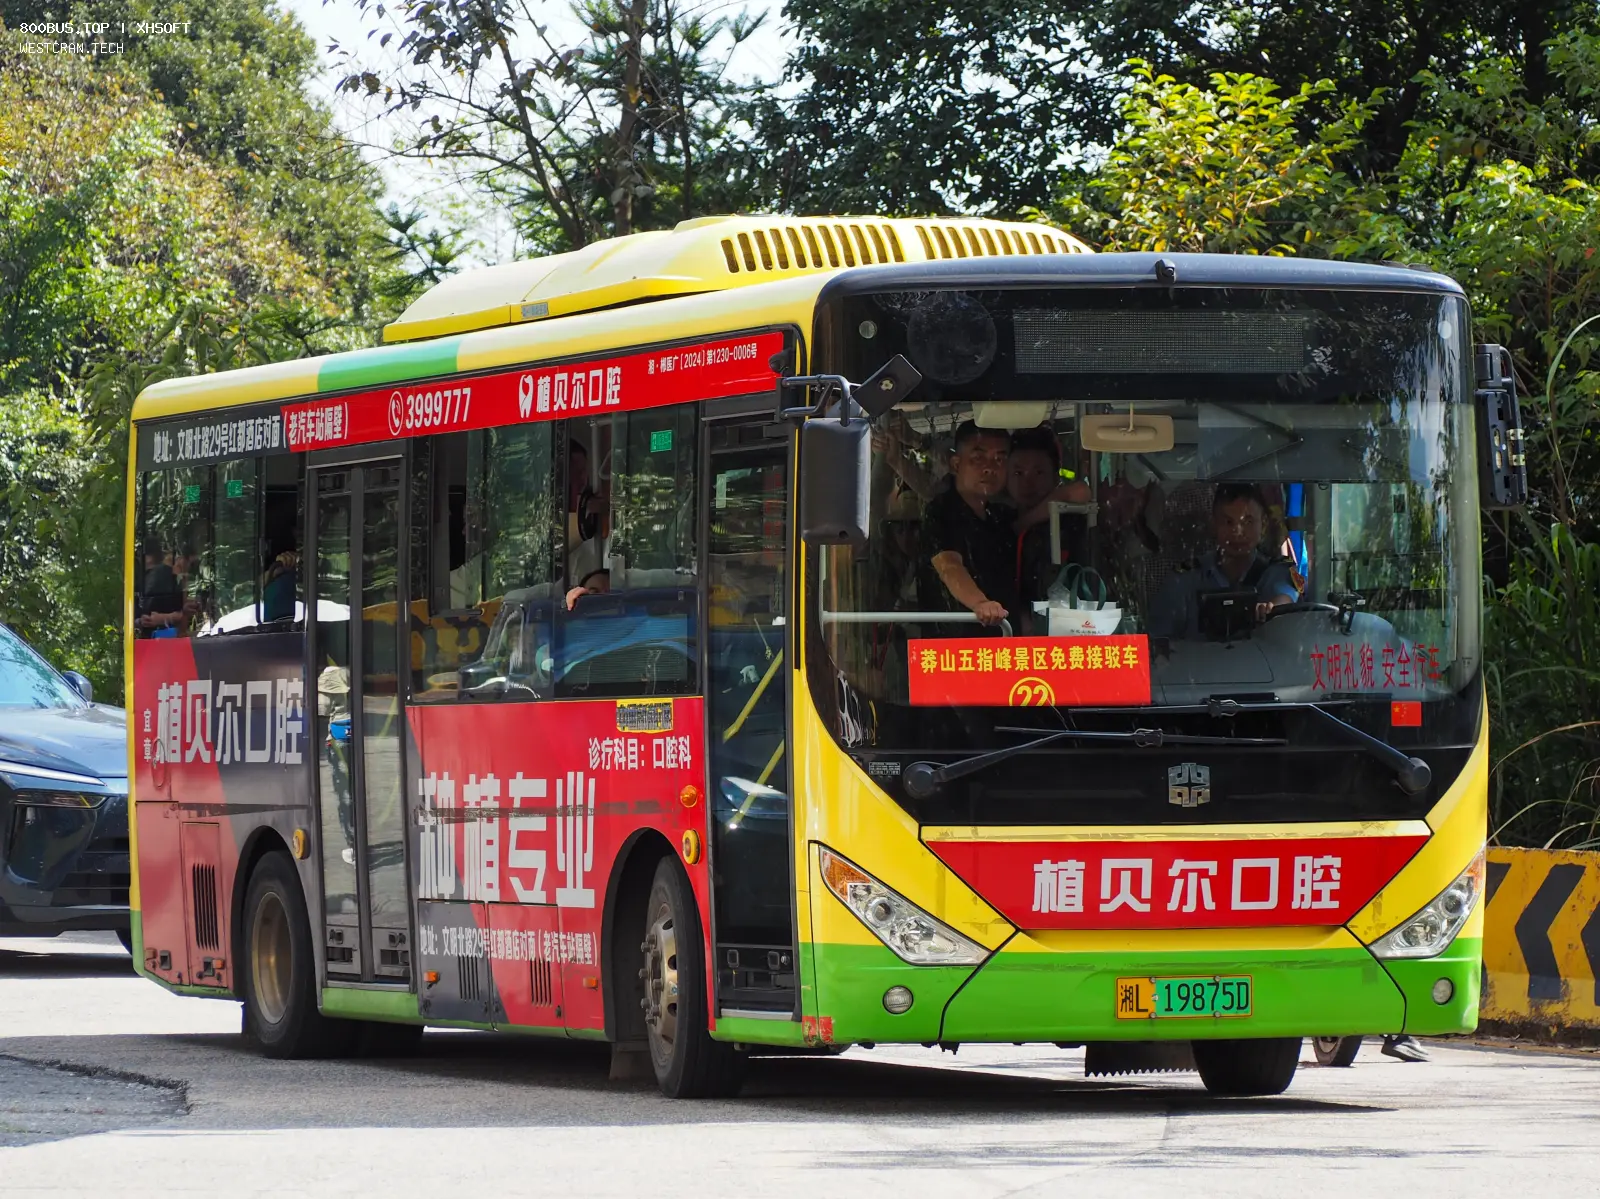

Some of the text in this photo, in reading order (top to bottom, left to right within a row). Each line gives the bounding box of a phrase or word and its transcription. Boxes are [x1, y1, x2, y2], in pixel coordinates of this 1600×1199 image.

[405, 387, 472, 430] 3999777
[535, 366, 622, 414] 植贝尔口腔
[920, 645, 1139, 673] 莽山五指峰景区免费接驳车
[1310, 640, 1443, 691] 文明礼貌 安全行车
[1015, 682, 1050, 706] 22
[143, 708, 152, 763] 宜章
[156, 678, 304, 764] 植贝尔口腔
[1032, 855, 1342, 913] 植贝尔口腔
